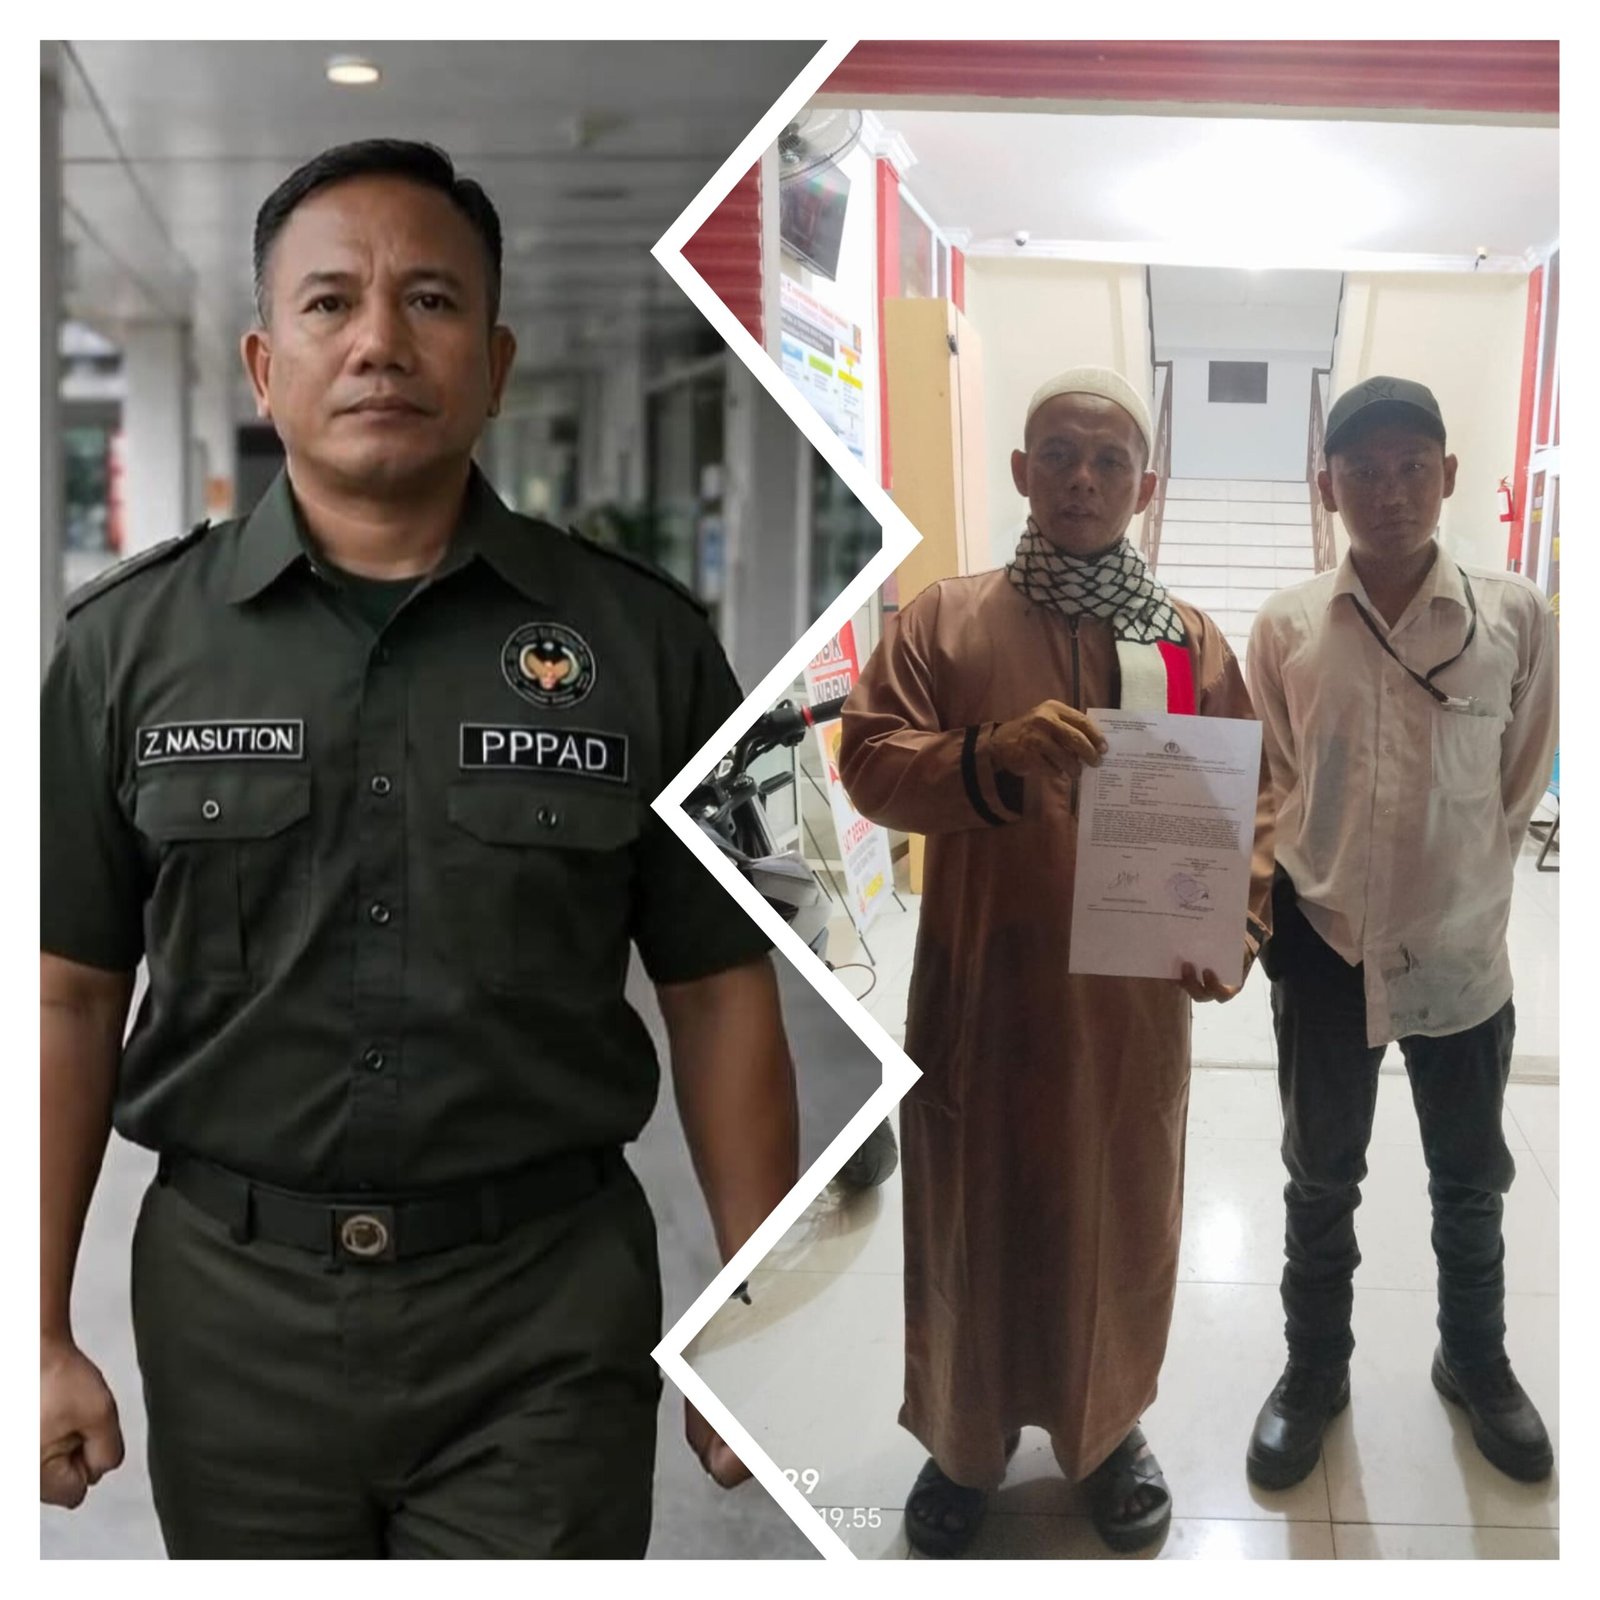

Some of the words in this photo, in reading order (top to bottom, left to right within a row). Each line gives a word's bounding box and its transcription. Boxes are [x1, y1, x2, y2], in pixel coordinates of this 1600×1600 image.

[144, 731, 162, 760] Z
[166, 727, 294, 754] NASUTION
[482, 731, 607, 770] PPPAD
